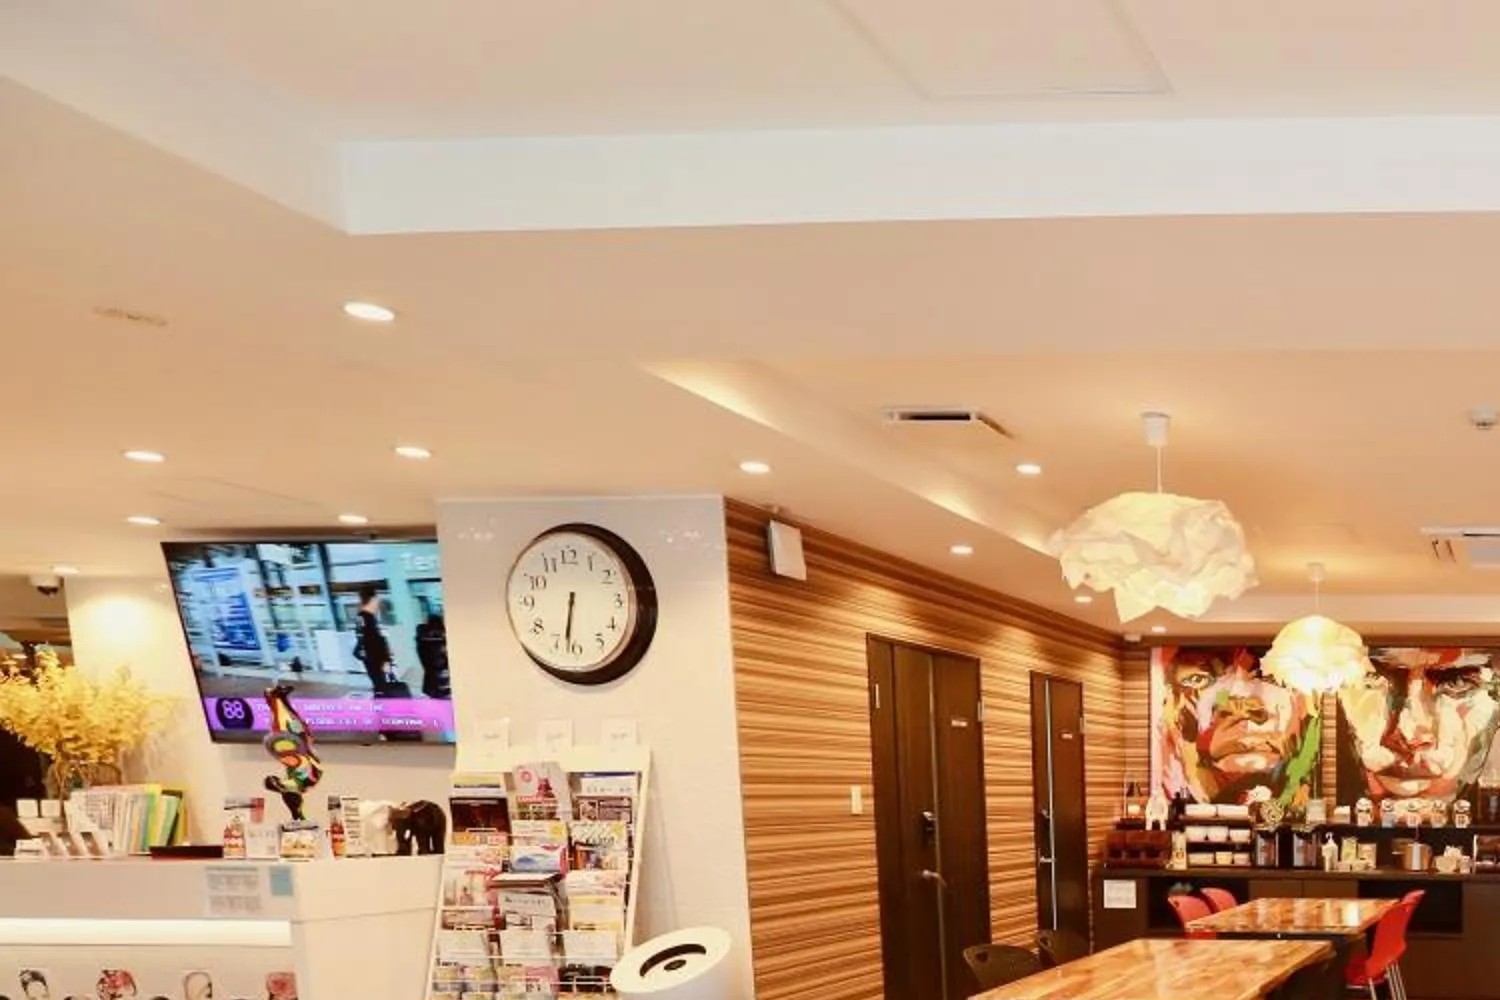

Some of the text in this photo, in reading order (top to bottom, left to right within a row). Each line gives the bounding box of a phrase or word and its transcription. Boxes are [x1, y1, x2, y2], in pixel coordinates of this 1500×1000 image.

[543, 556, 558, 572] 11
[560, 550, 578, 565] 12
[587, 554, 594, 571] 1
[529, 575, 547, 590] 10
[601, 569, 614, 584] 2
[523, 595, 535, 611] 9
[614, 594, 623, 608] 3
[531, 618, 545, 635] 8
[606, 616, 617, 631] 4
[551, 633, 560, 649] 7
[571, 640, 583, 656] 6
[594, 633, 605, 648] 5
